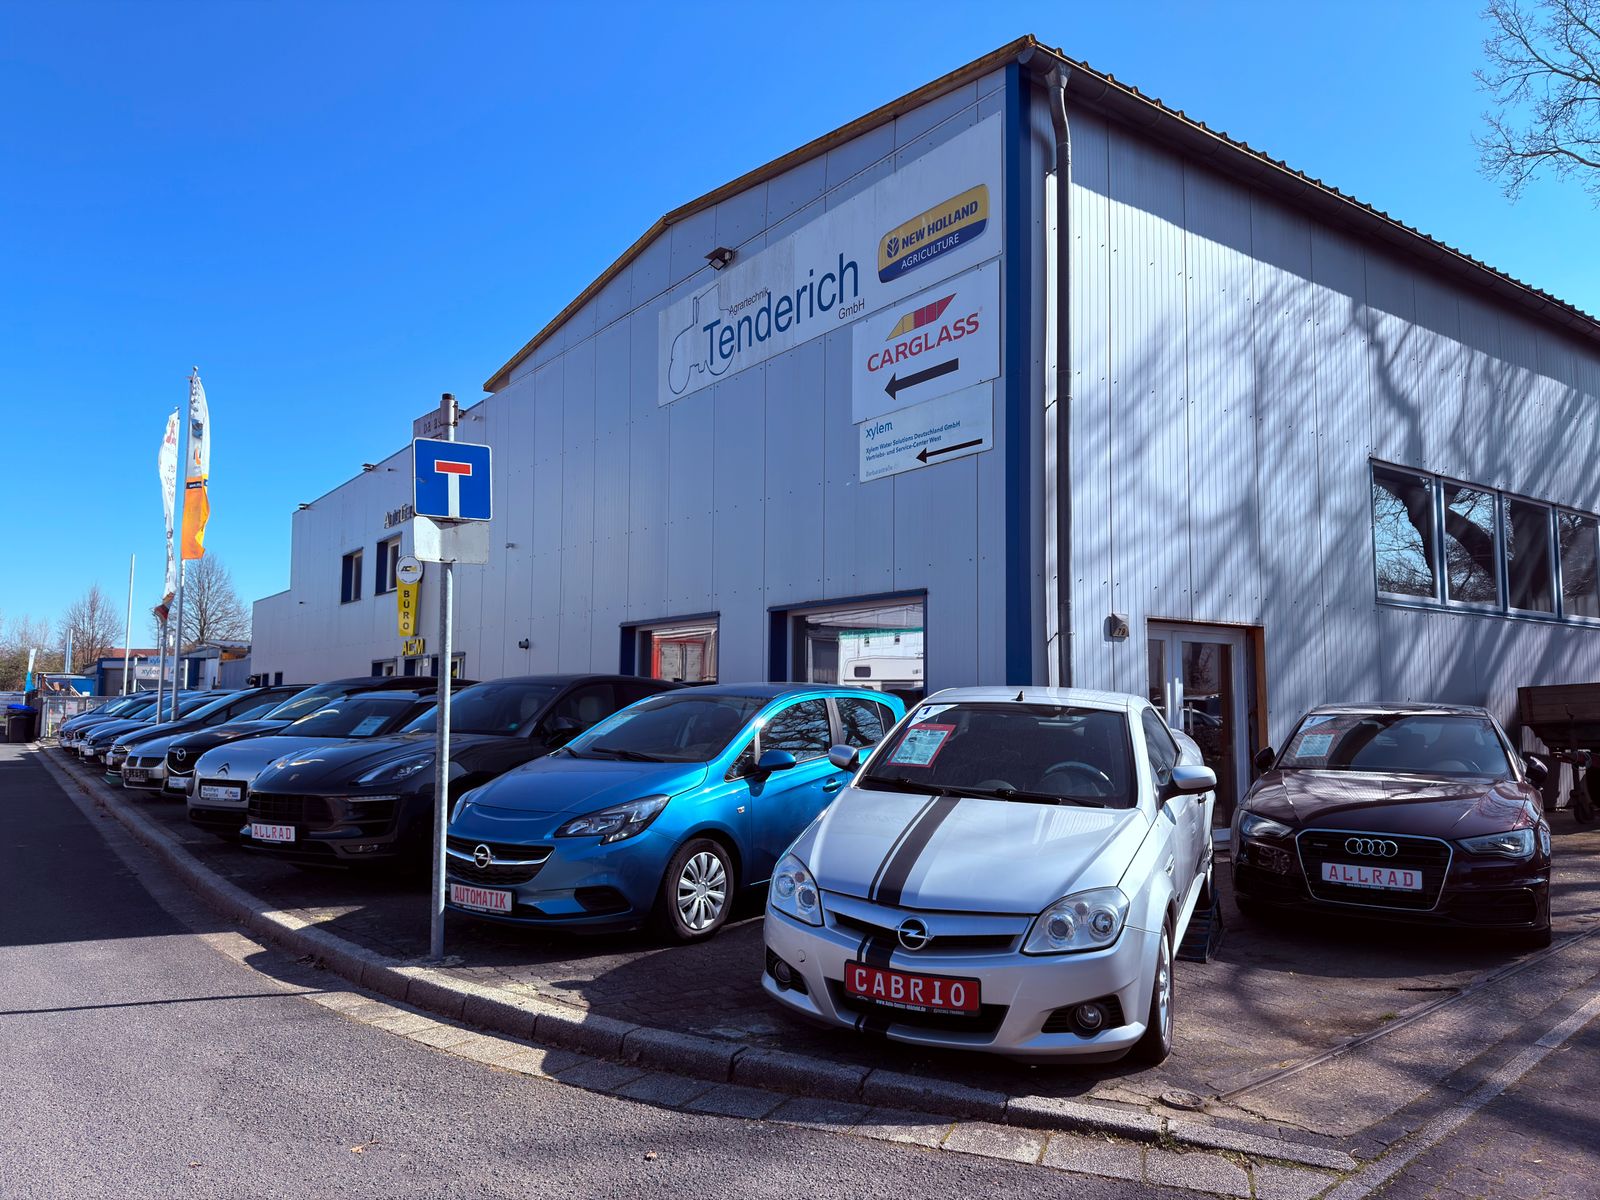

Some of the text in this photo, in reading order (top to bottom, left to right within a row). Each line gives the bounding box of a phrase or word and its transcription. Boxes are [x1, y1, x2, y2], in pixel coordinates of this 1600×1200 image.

[902, 200, 978, 249] NEW HOLLAND
[901, 233, 960, 270] AGRICULTURE
[703, 252, 859, 366] Tenderich
[728, 286, 770, 316] Agrartechnik
[838, 298, 865, 320] GmbH
[867, 312, 980, 372] CARGLASS
[865, 421, 893, 440] xylem
[865, 420, 961, 455] Xylem Water Solutions Deutschland GmbH
[886, 448, 895, 456] und
[895, 439, 928, 453] Service-Center
[929, 435, 942, 444] West
[402, 638, 426, 656] ACM
[254, 825, 291, 840] ALLRAD
[1329, 865, 1414, 887] ALLRAD
[454, 886, 506, 909] AUTOMATIK
[855, 968, 965, 1007] CABRIO
